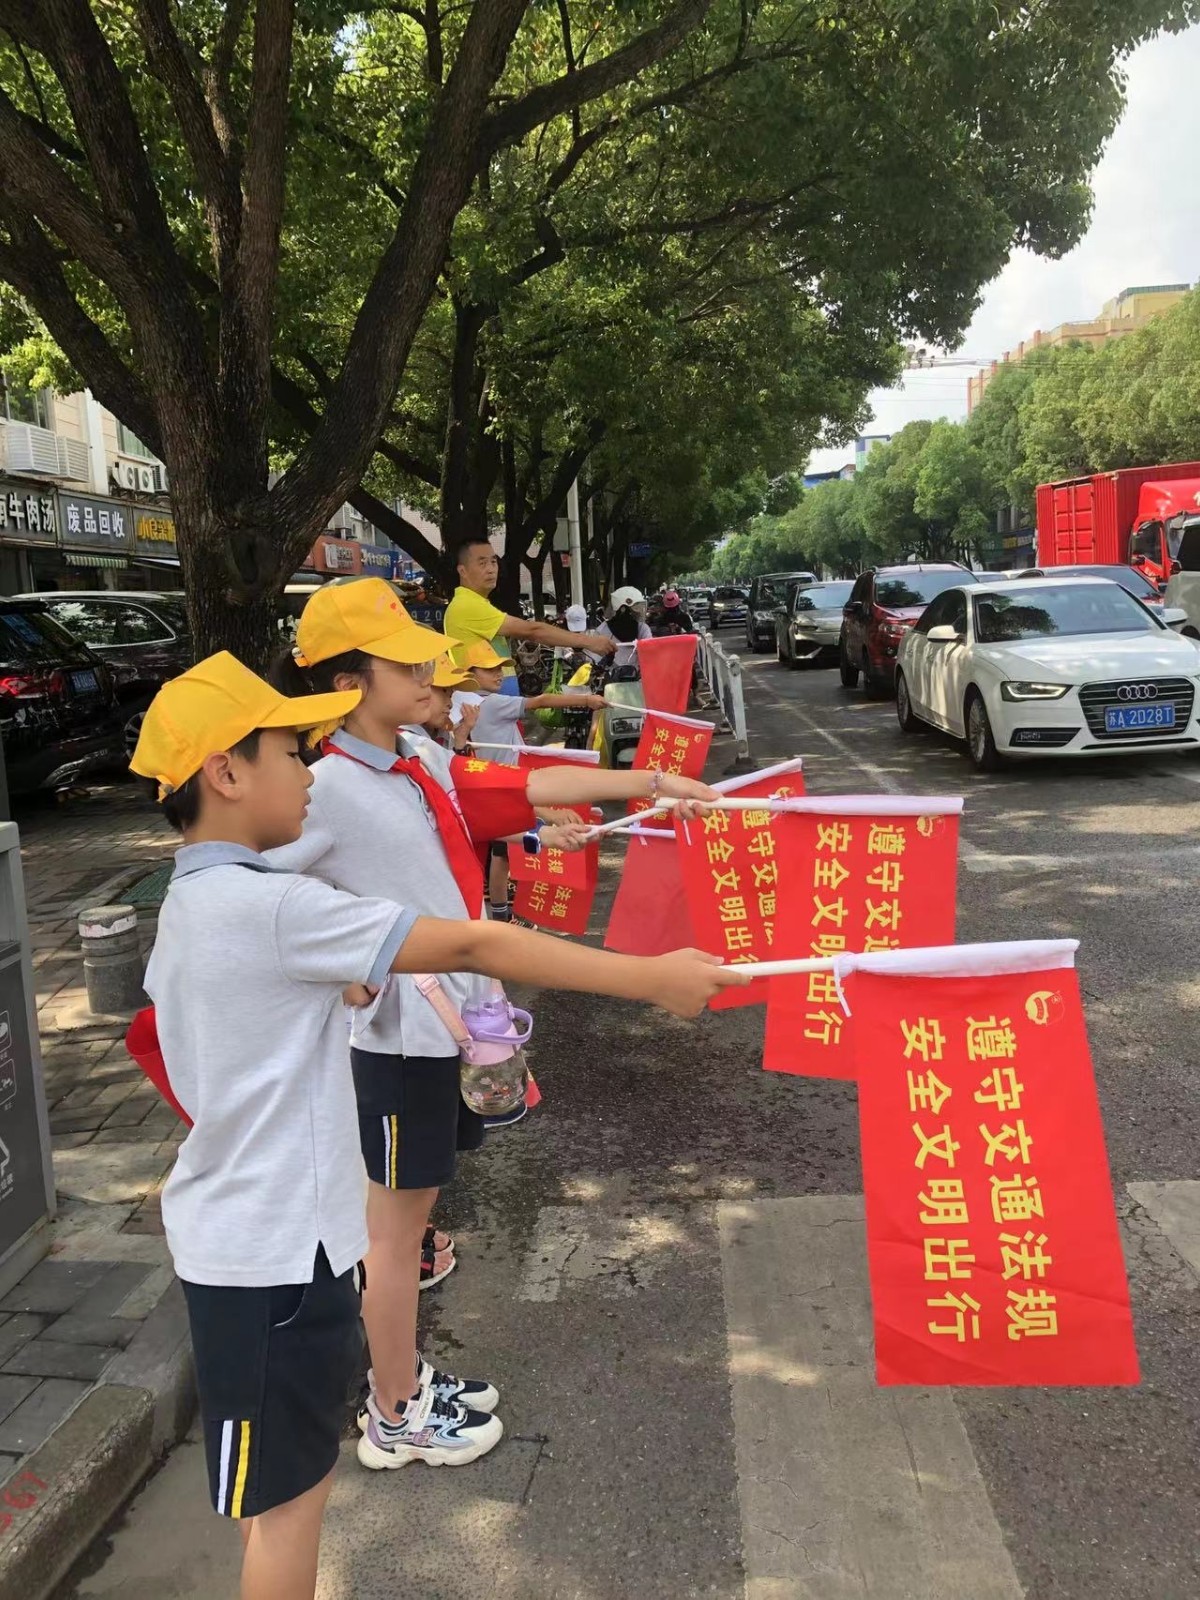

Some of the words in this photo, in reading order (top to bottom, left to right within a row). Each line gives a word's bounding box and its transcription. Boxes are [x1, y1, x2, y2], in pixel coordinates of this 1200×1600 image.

[67, 503, 125, 538] 废品回收
[899, 1016, 982, 1343] 安全文明出行
[965, 1015, 1059, 1342] 遵守交通法规
